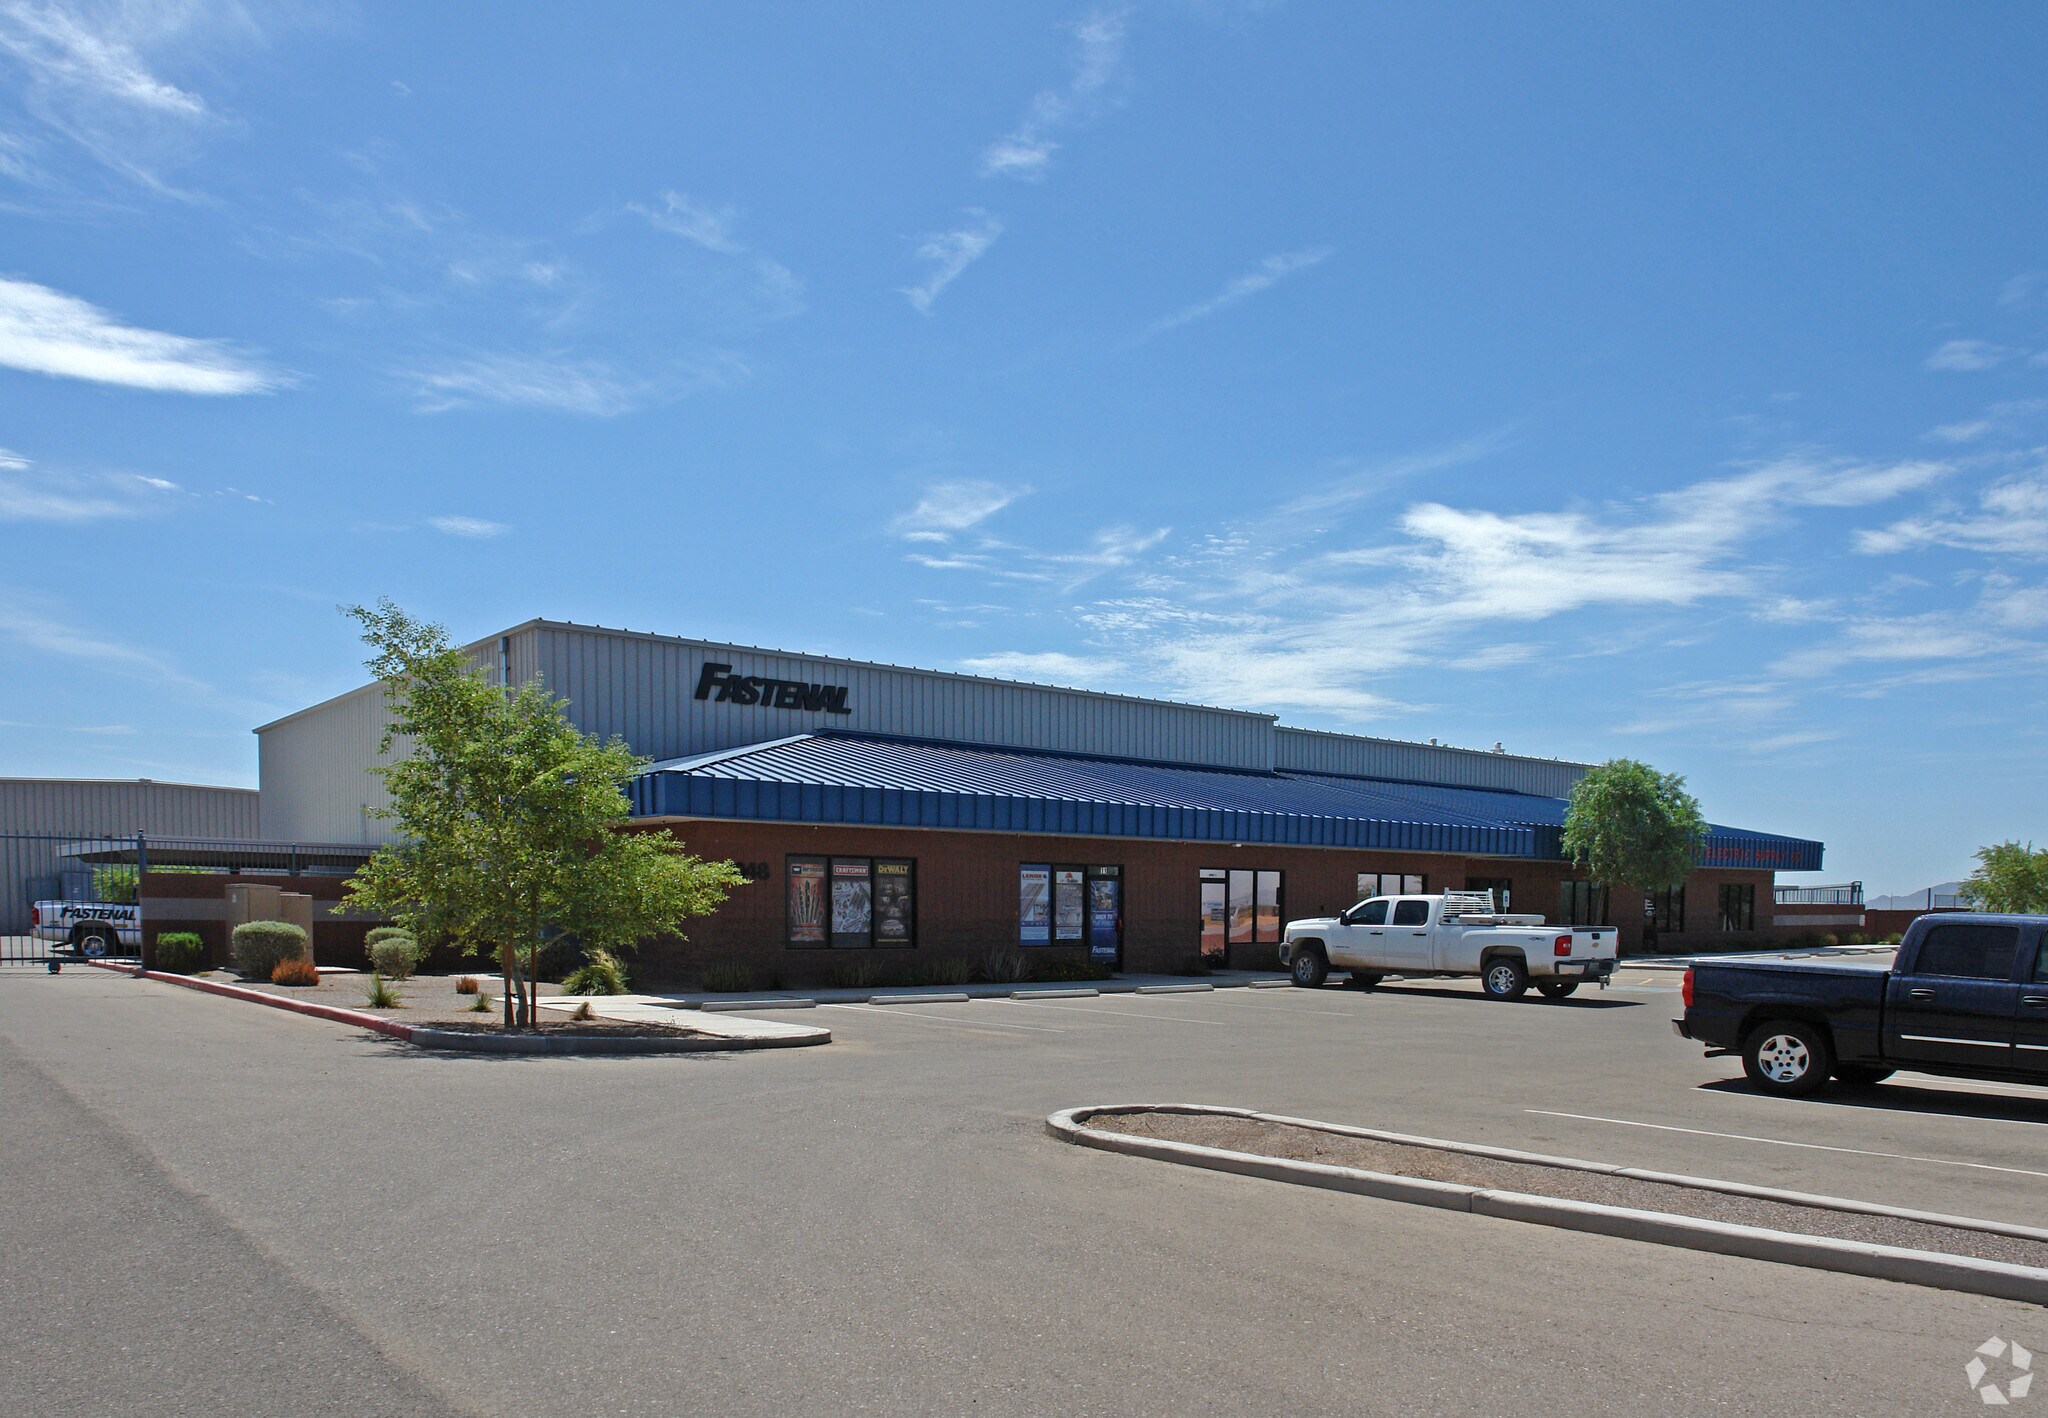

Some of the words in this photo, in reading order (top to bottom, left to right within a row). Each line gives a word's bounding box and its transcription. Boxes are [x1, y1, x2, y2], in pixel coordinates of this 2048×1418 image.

[695, 662, 852, 715] FASTENAL
[1706, 846, 1750, 860] ELECTRIC
[1755, 849, 1786, 862] SUPPLY
[835, 867, 867, 875] CRAFTSMAN
[60, 905, 136, 920] FASTENAL
[1091, 945, 1116, 954] FASTENAL
